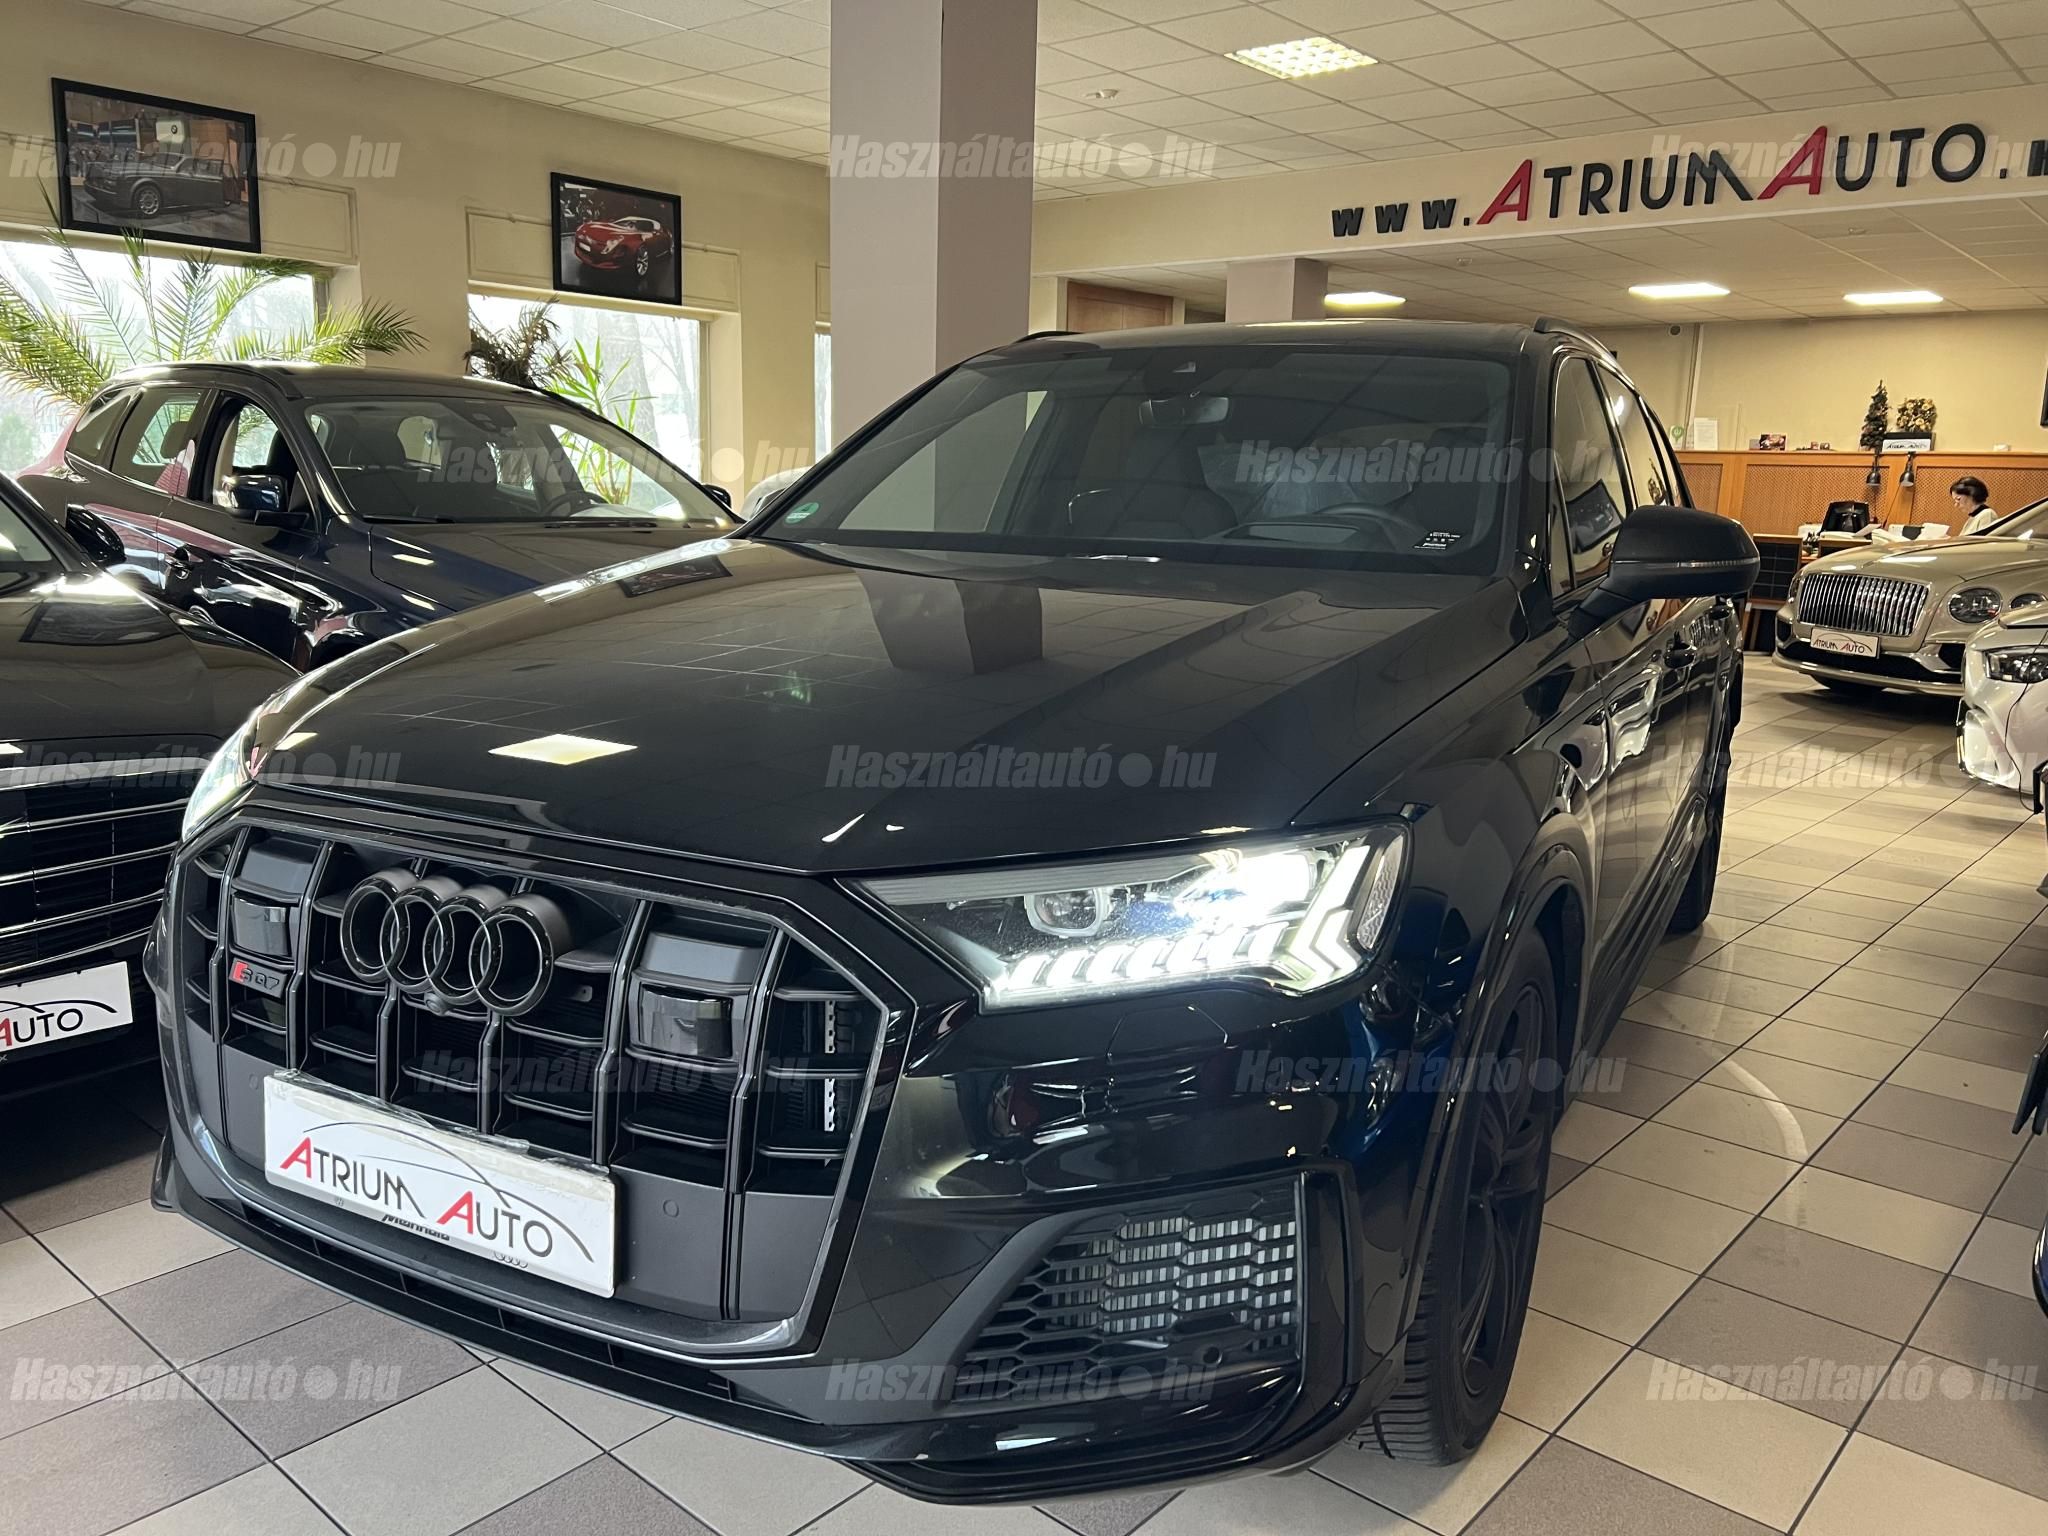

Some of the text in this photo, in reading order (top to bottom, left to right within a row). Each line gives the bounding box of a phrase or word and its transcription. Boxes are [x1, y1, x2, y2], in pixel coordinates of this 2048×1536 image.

[1813, 638, 1865, 654] ATRIUM AUTO
[233, 960, 280, 990] SQ7
[279, 1136, 554, 1258] ATRIUM AUTO
